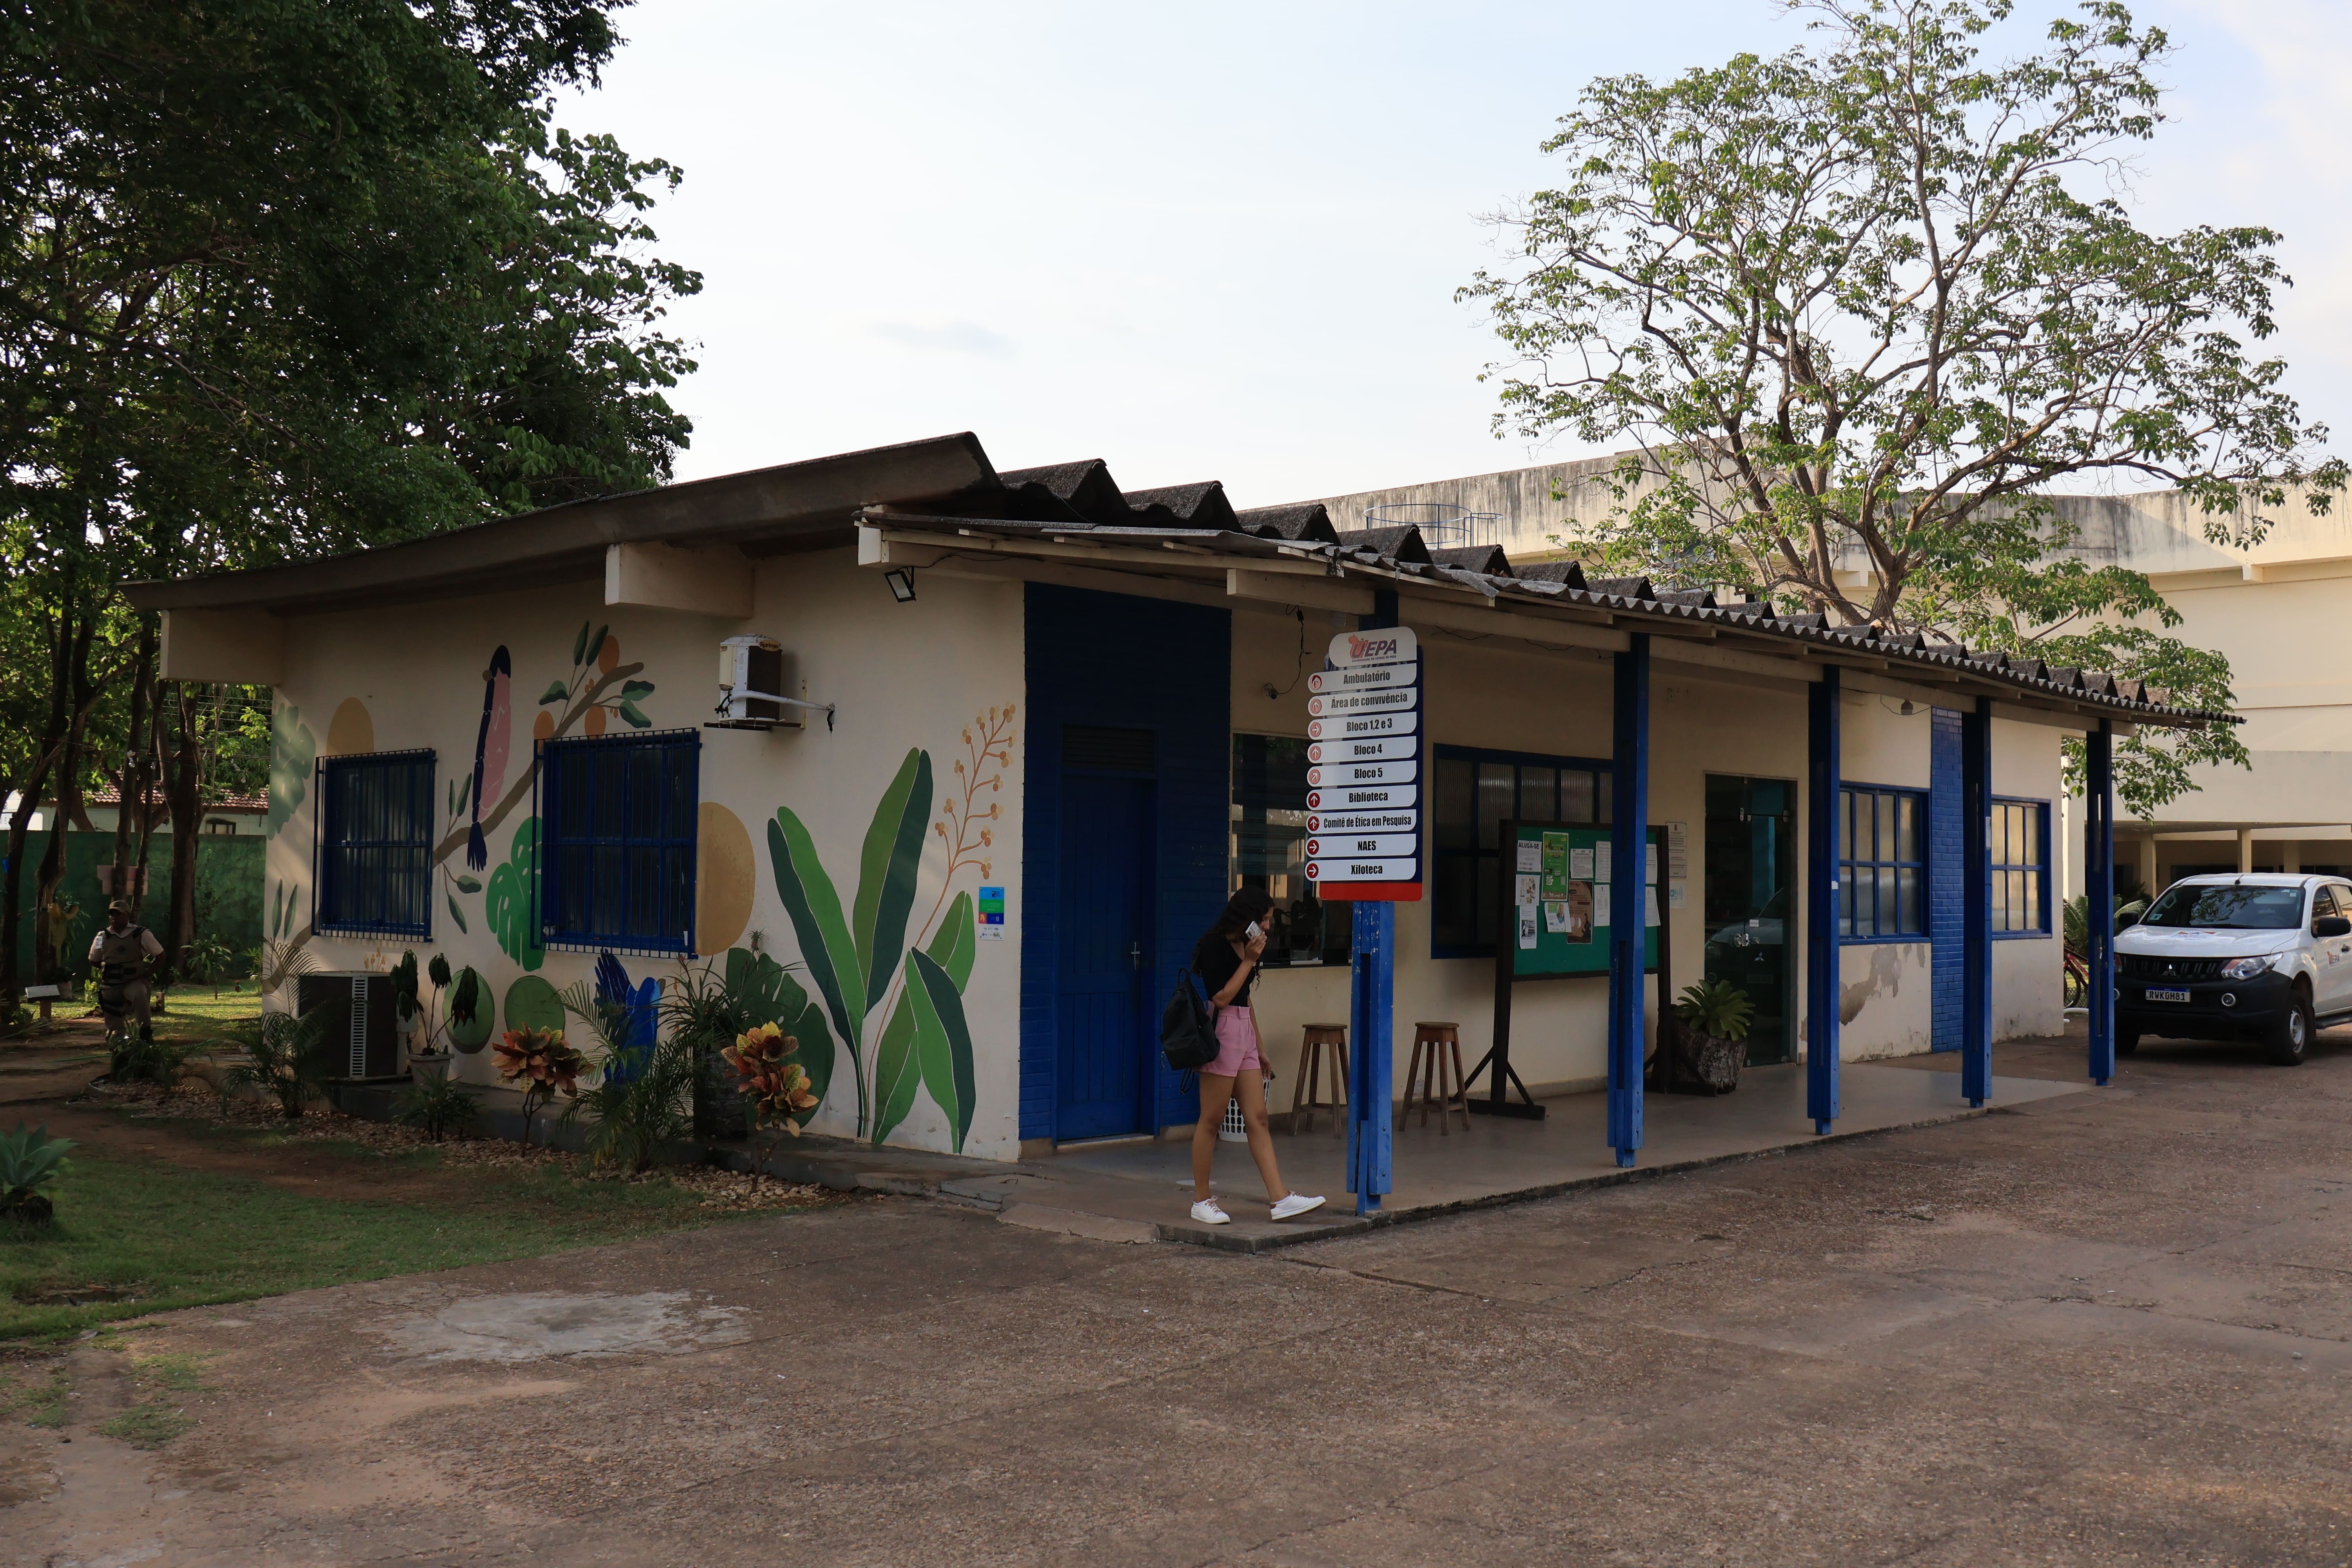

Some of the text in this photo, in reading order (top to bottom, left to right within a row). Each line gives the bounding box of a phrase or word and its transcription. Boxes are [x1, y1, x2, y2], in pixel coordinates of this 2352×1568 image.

[1351, 639, 1397, 658] UEPA
[1343, 671, 1390, 684] Ambulatório
[1331, 693, 1407, 709] Área de convivência
[1347, 718, 1392, 731] Bloco 1,2 e 3
[1354, 744, 1382, 755] Bloco 4
[1354, 768, 1383, 779] Bloco 5
[1349, 792, 1388, 802] Biblioteca
[1324, 815, 1411, 828] Comitê de Ética em Pesquisa
[1357, 840, 1376, 851] NAES
[1351, 865, 1383, 875] Xiloteca
